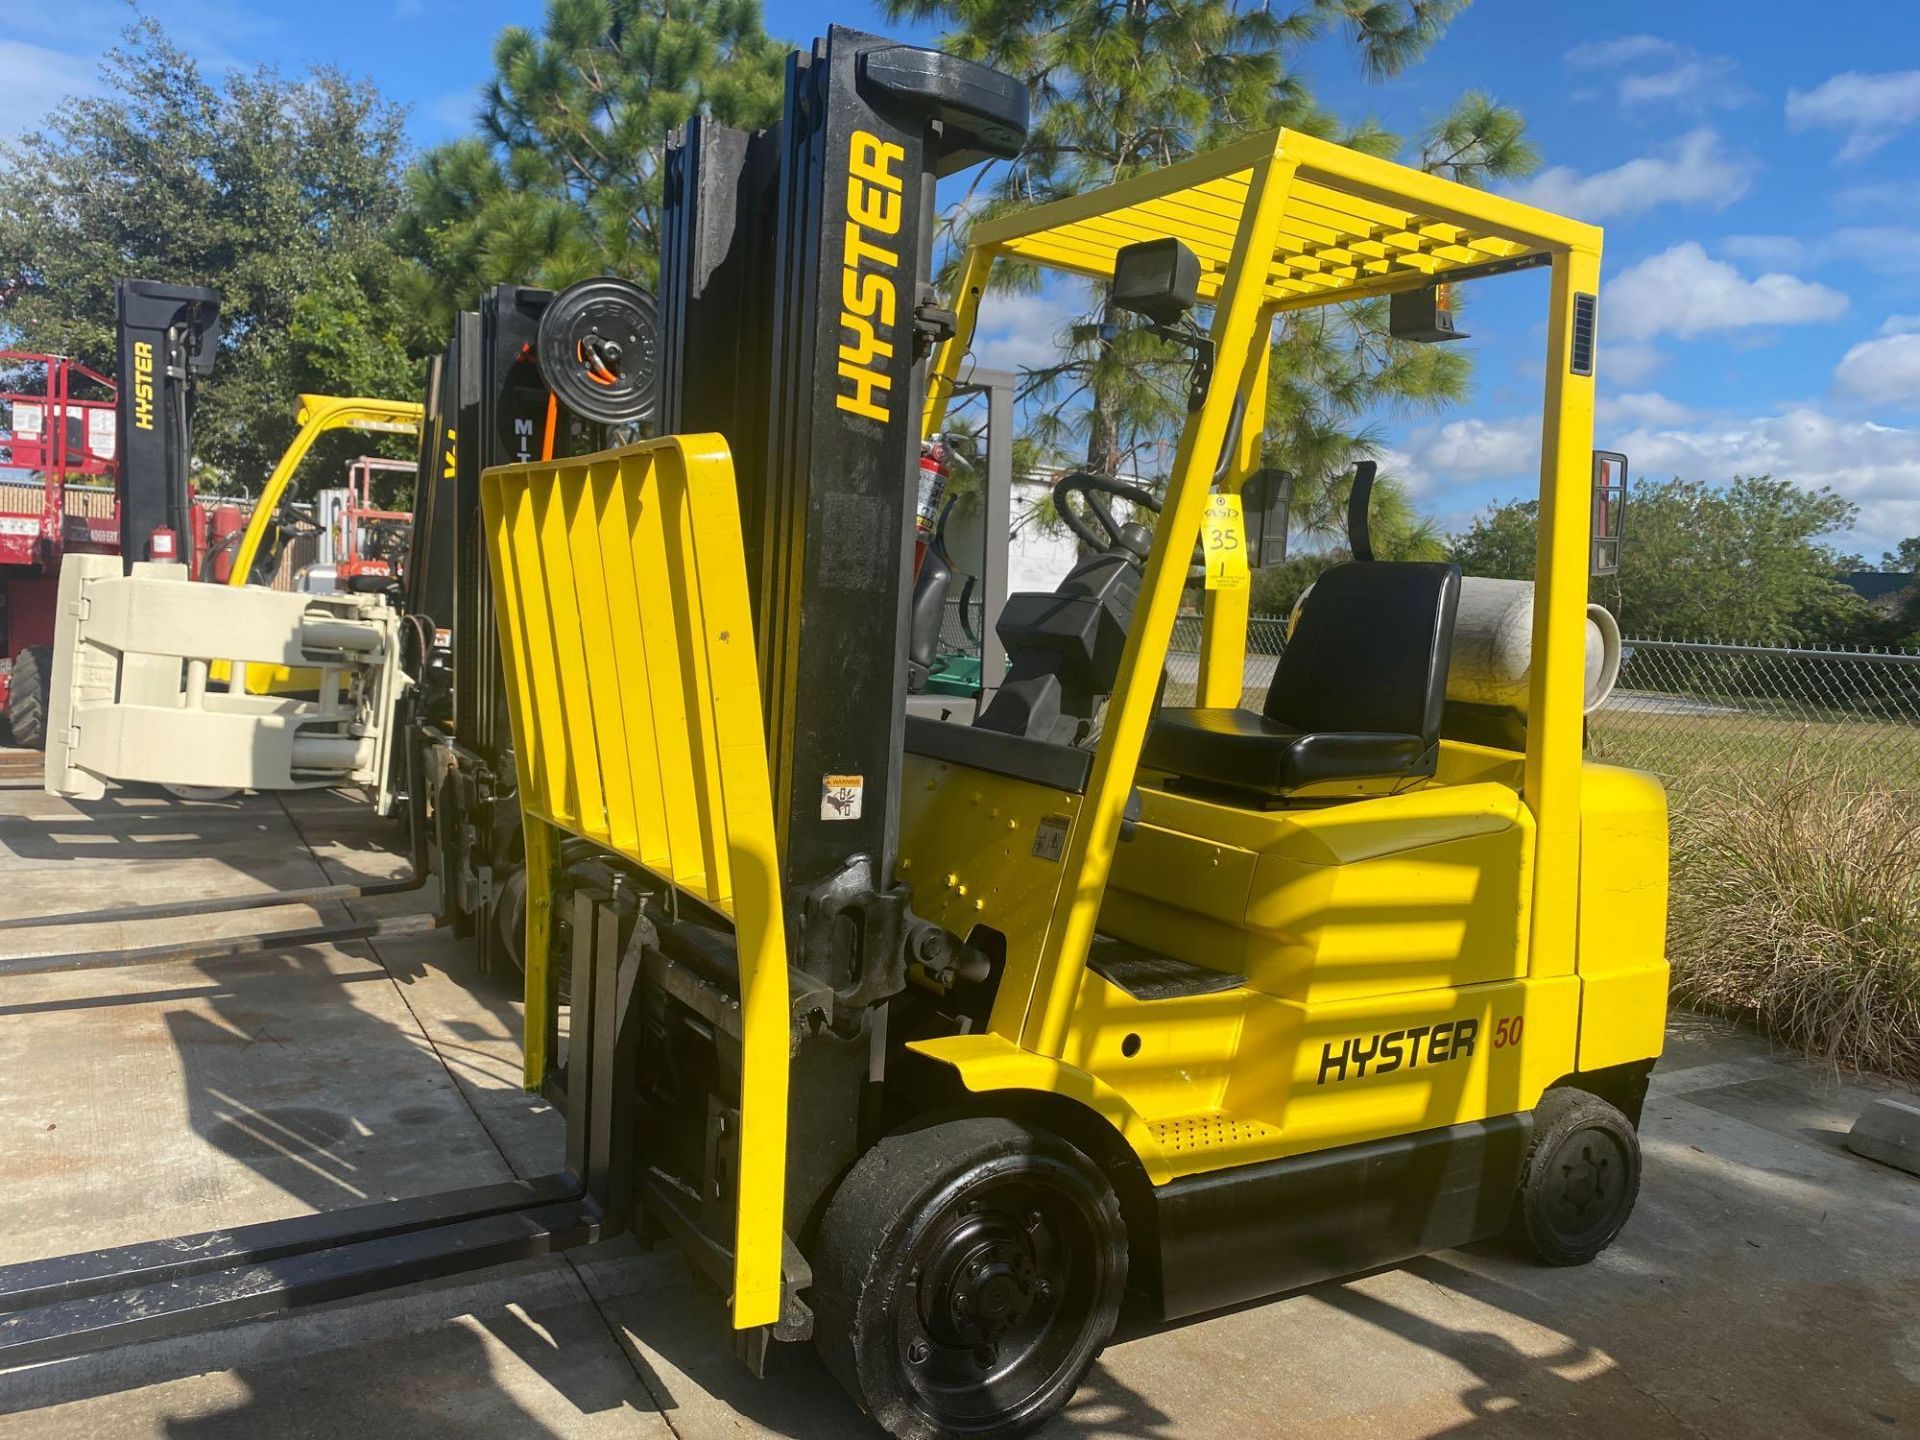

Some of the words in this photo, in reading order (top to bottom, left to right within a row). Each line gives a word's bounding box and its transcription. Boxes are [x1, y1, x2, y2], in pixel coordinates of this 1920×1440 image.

[836, 130, 905, 423] HYSTER
[134, 341, 154, 431] HYSTER
[515, 418, 533, 464] MIT
[1210, 528, 1239, 550] 35
[361, 566, 391, 577] SKY
[1316, 1018, 1479, 1085] HYSTER
[1493, 1015, 1524, 1049] 50
